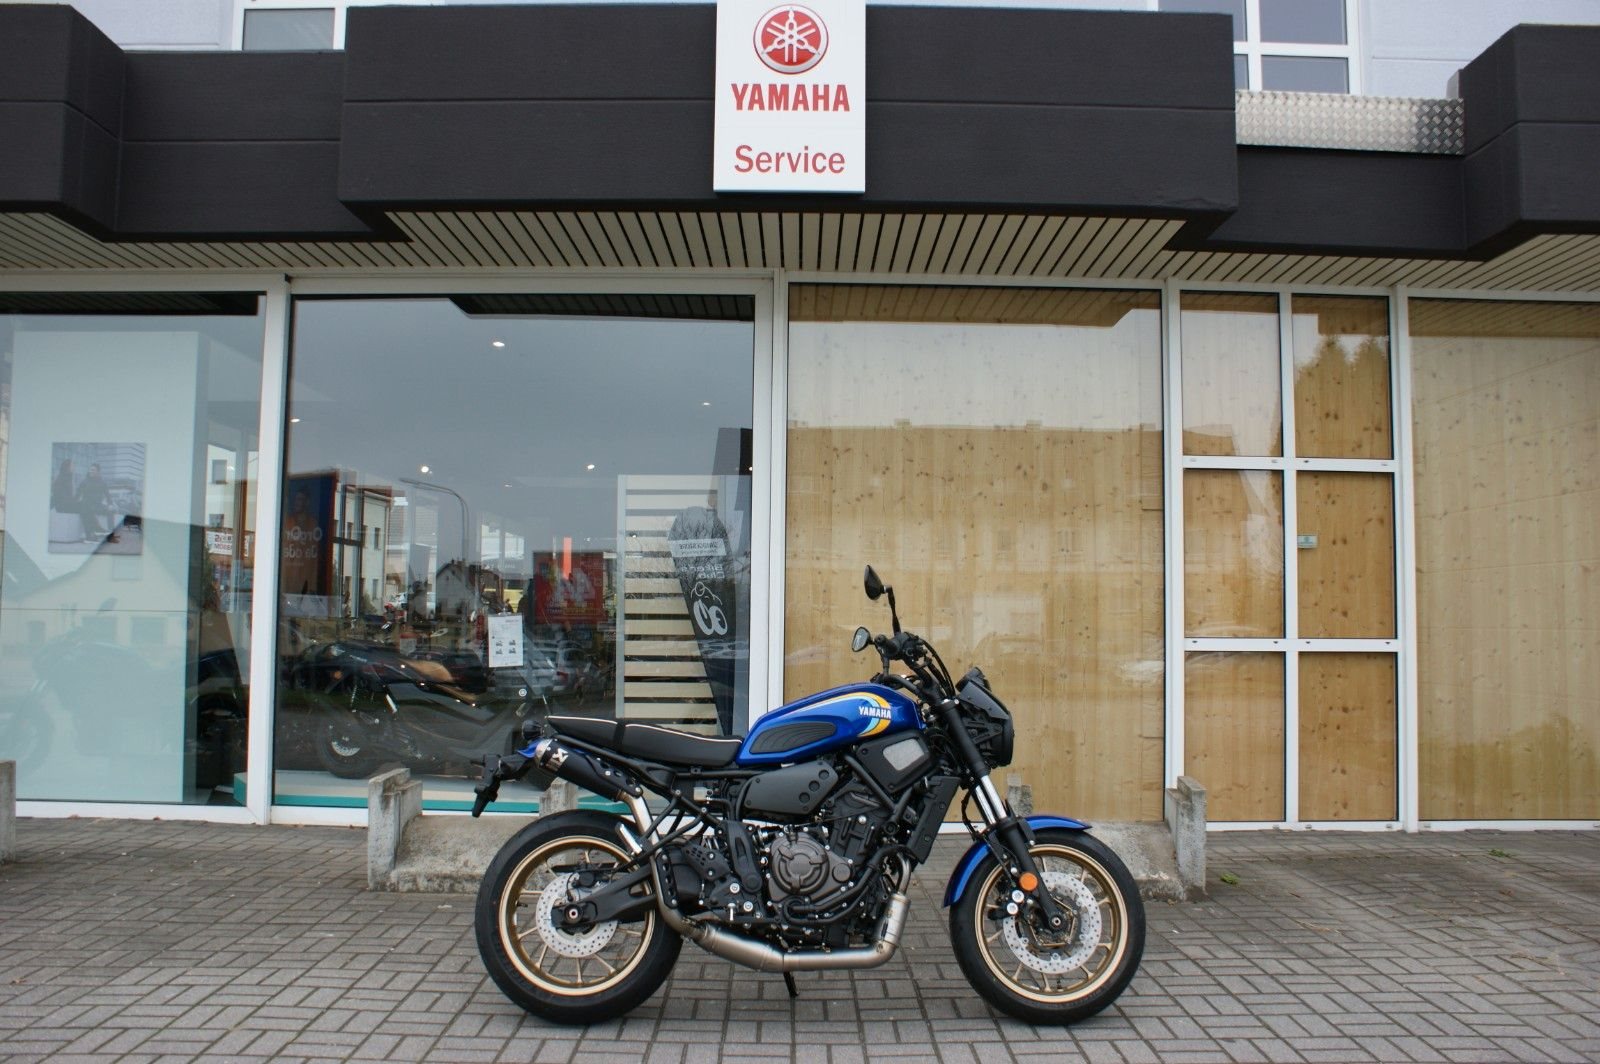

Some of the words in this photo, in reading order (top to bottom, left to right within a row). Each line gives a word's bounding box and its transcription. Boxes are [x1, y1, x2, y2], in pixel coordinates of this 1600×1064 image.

[731, 83, 850, 112] YAMAHA
[734, 145, 845, 174] Service
[858, 706, 891, 719] YAMAHA
